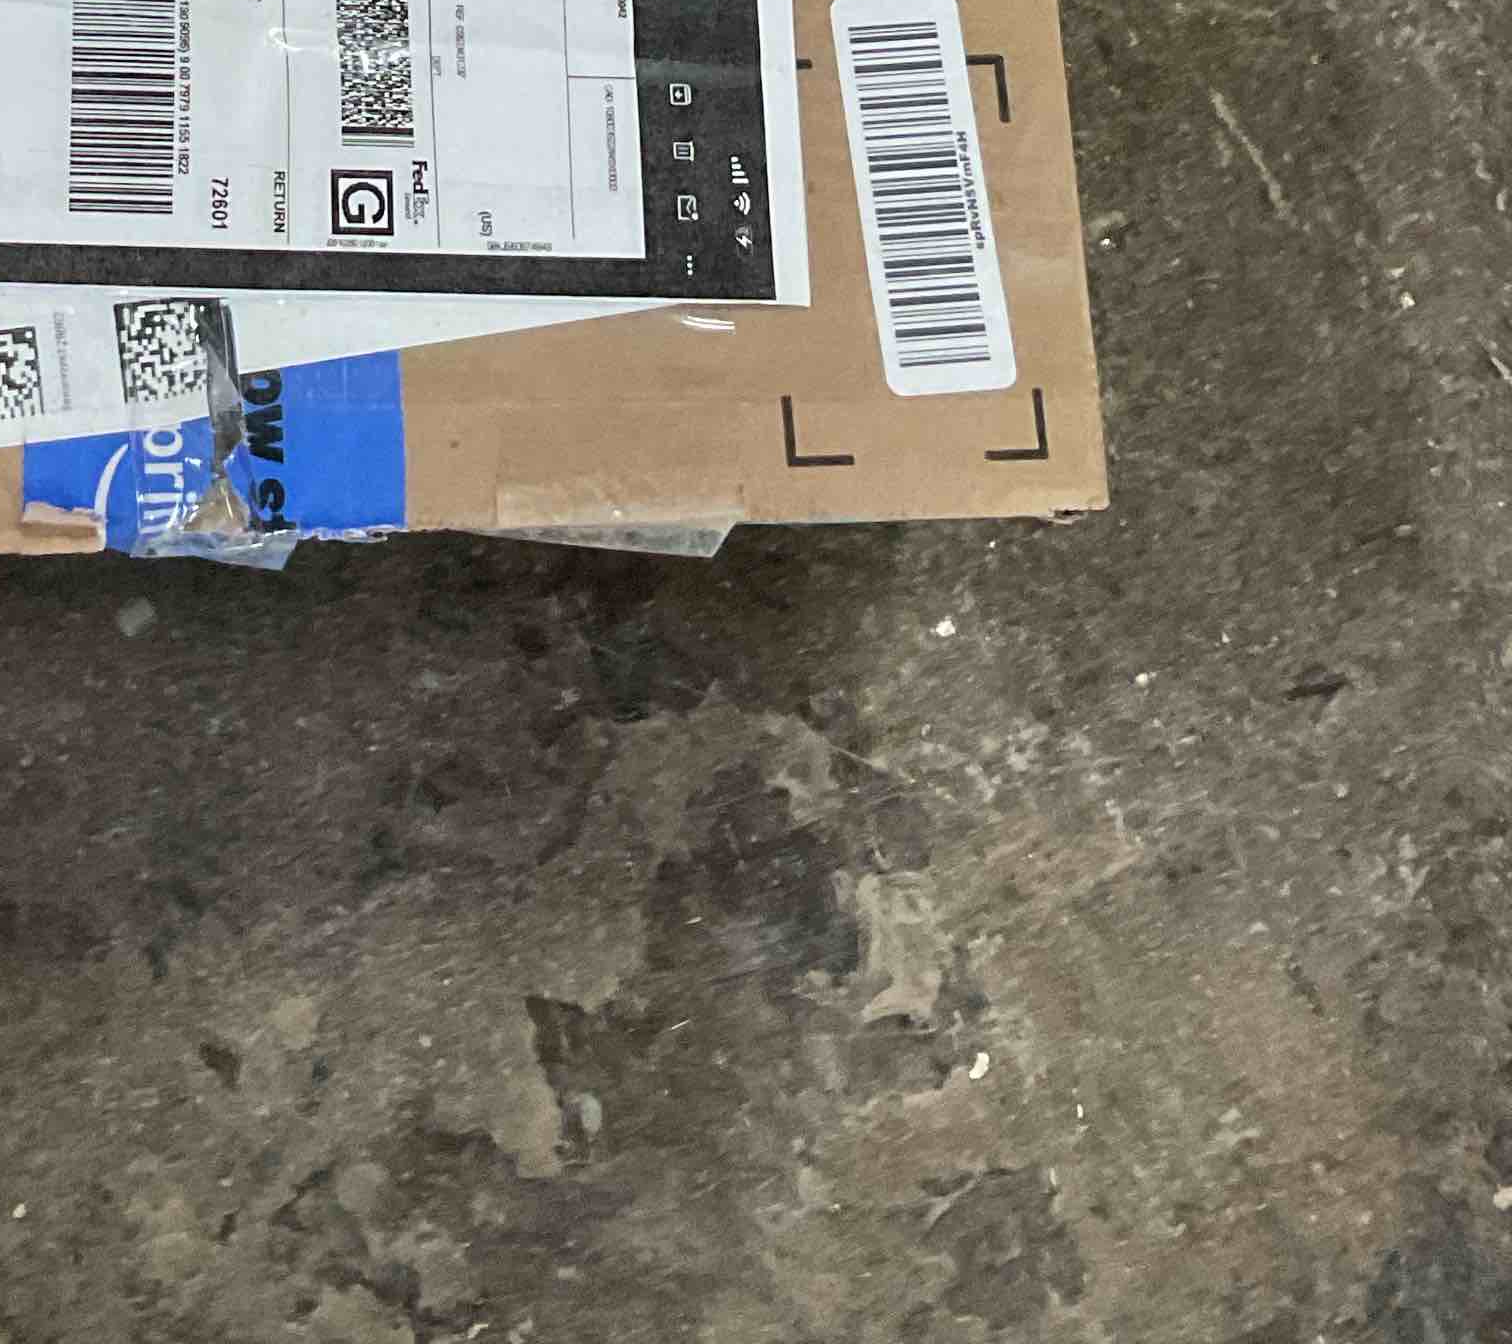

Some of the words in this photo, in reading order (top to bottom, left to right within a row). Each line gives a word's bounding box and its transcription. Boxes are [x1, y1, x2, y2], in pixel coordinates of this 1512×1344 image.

[178, 83, 191, 112] 7979
[178, 115, 191, 145] 1155
[178, 148, 191, 175] 1822
[211, 176, 229, 231] 72601
[272, 170, 287, 234] RETURN
[342, 181, 386, 224] G
[478, 211, 494, 237] (US)
